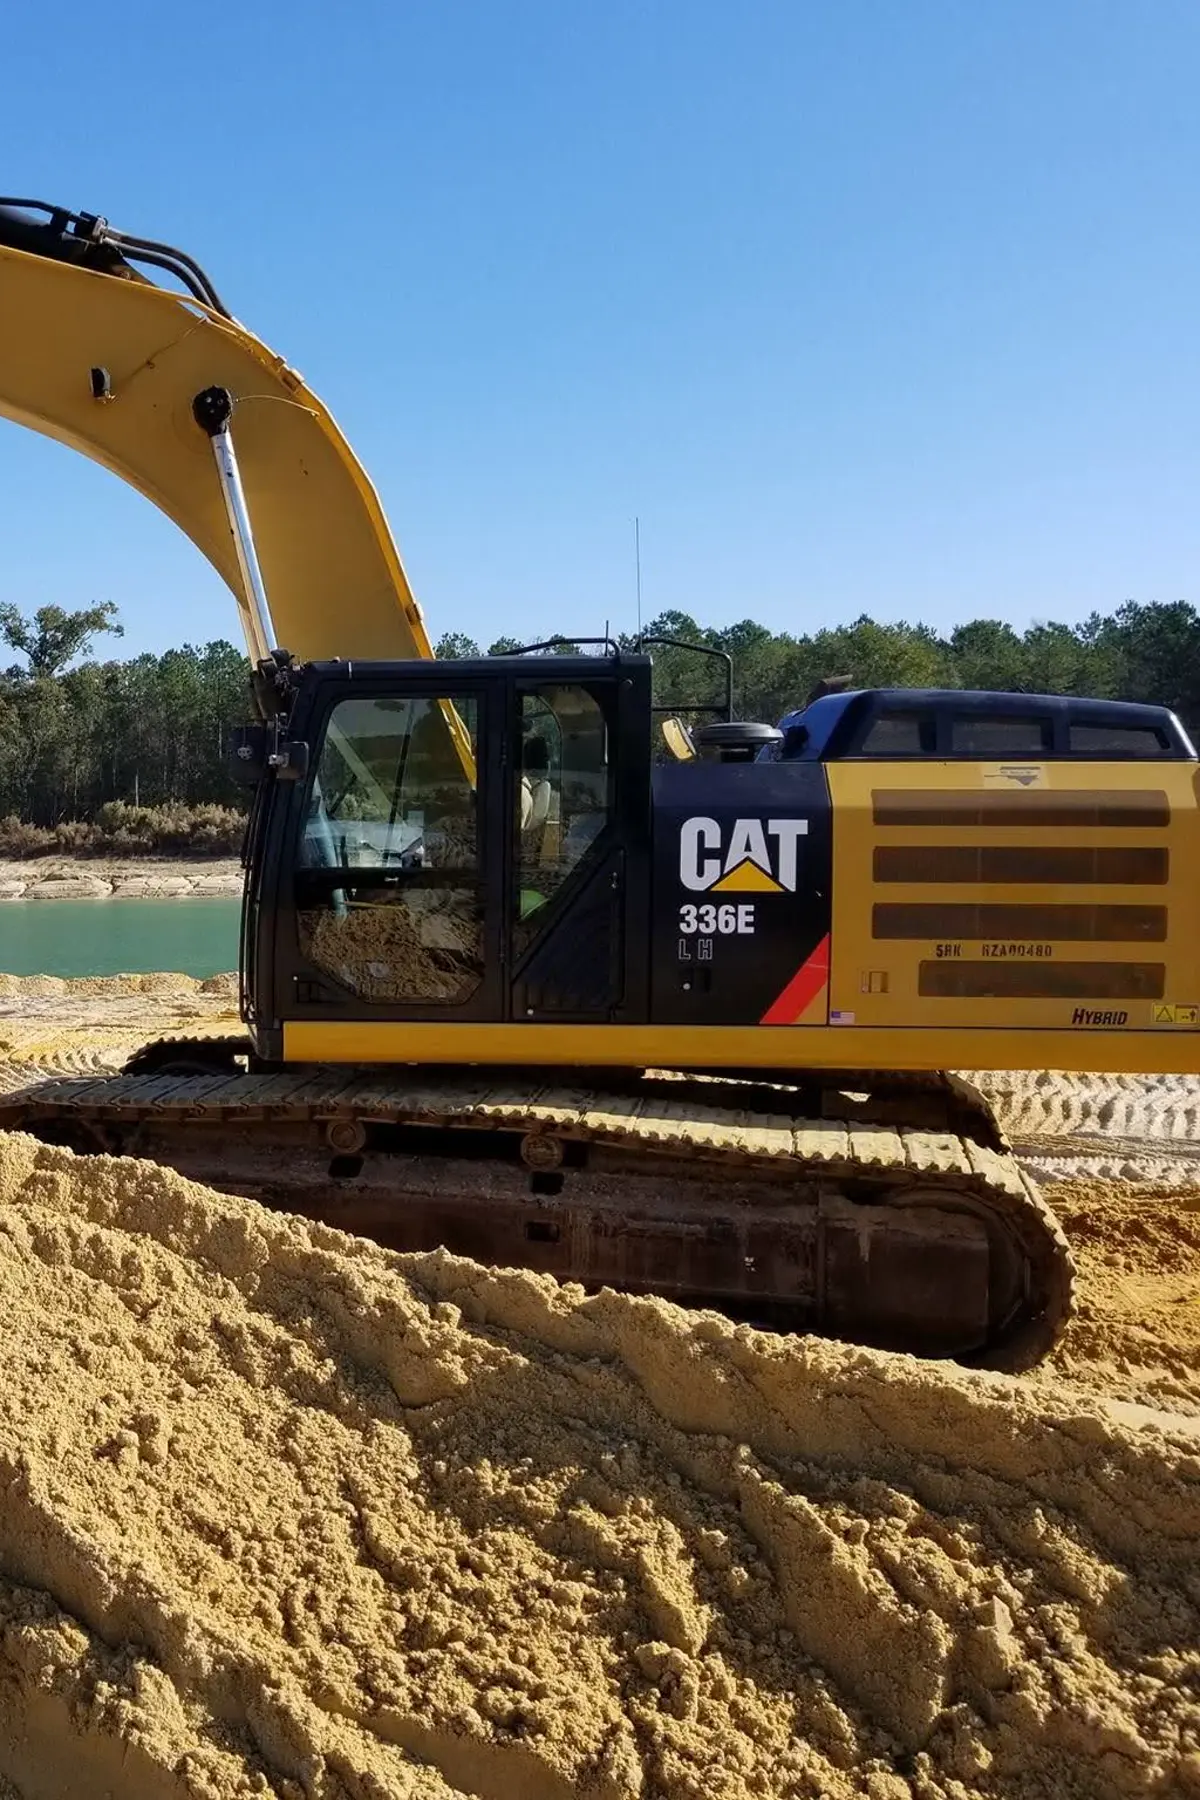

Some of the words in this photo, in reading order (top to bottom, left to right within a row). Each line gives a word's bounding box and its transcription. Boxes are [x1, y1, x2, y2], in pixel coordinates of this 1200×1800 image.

[680, 816, 809, 892] CAT
[679, 904, 755, 934] 336E
[1071, 1008, 1129, 1026] HYBRID
